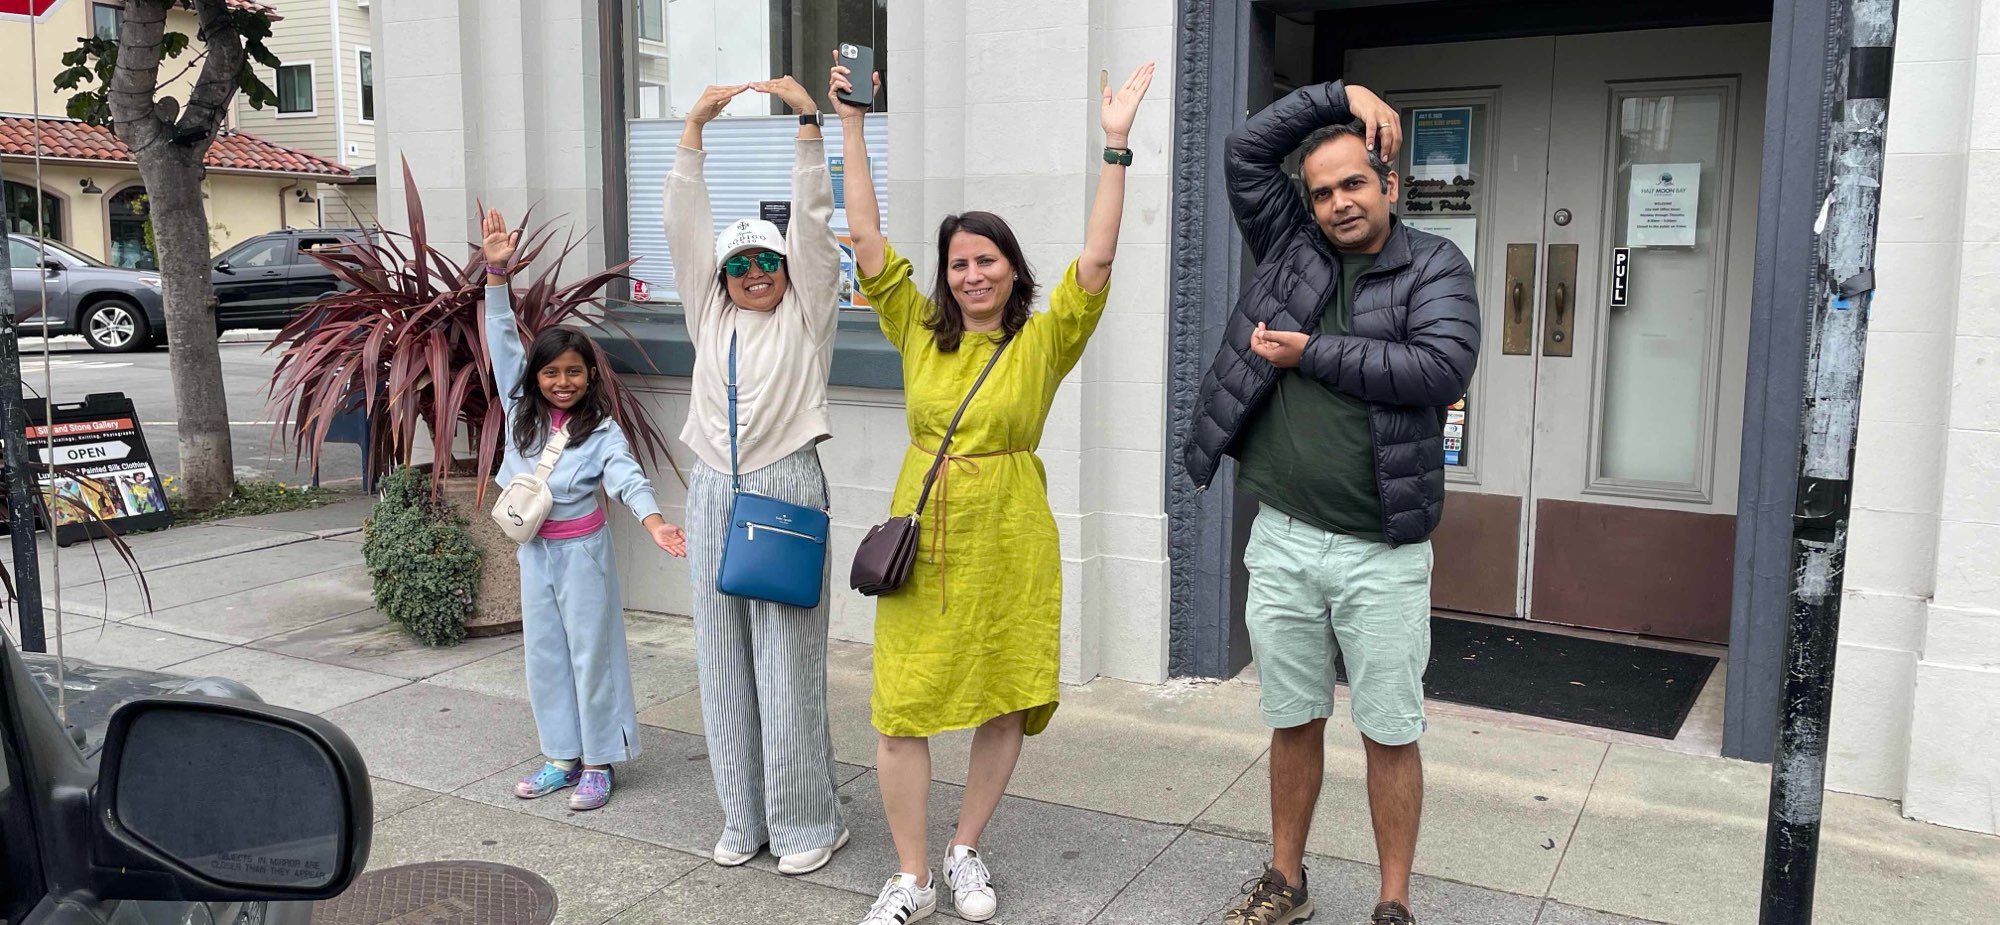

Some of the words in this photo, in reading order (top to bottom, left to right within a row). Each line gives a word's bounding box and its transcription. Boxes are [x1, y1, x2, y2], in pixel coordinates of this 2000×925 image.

[1439, 200, 1471, 211] Pride
[1615, 253, 1626, 301] PULL
[37, 427, 51, 435] Sil
[53, 425, 68, 433] and
[69, 424, 92, 432] Stone
[92, 421, 119, 431] Gallery
[67, 447, 106, 460] OPEN
[81, 465, 107, 475] Painted
[107, 464, 121, 472] Silk
[121, 461, 149, 470] Clothing
[211, 861, 241, 871] CLOSER
[246, 863, 266, 873] THAN
[271, 866, 290, 876] THEY
[294, 869, 326, 878] APPEAR
[270, 858, 301, 867] MIRROR
[304, 861, 320, 869] ARE
